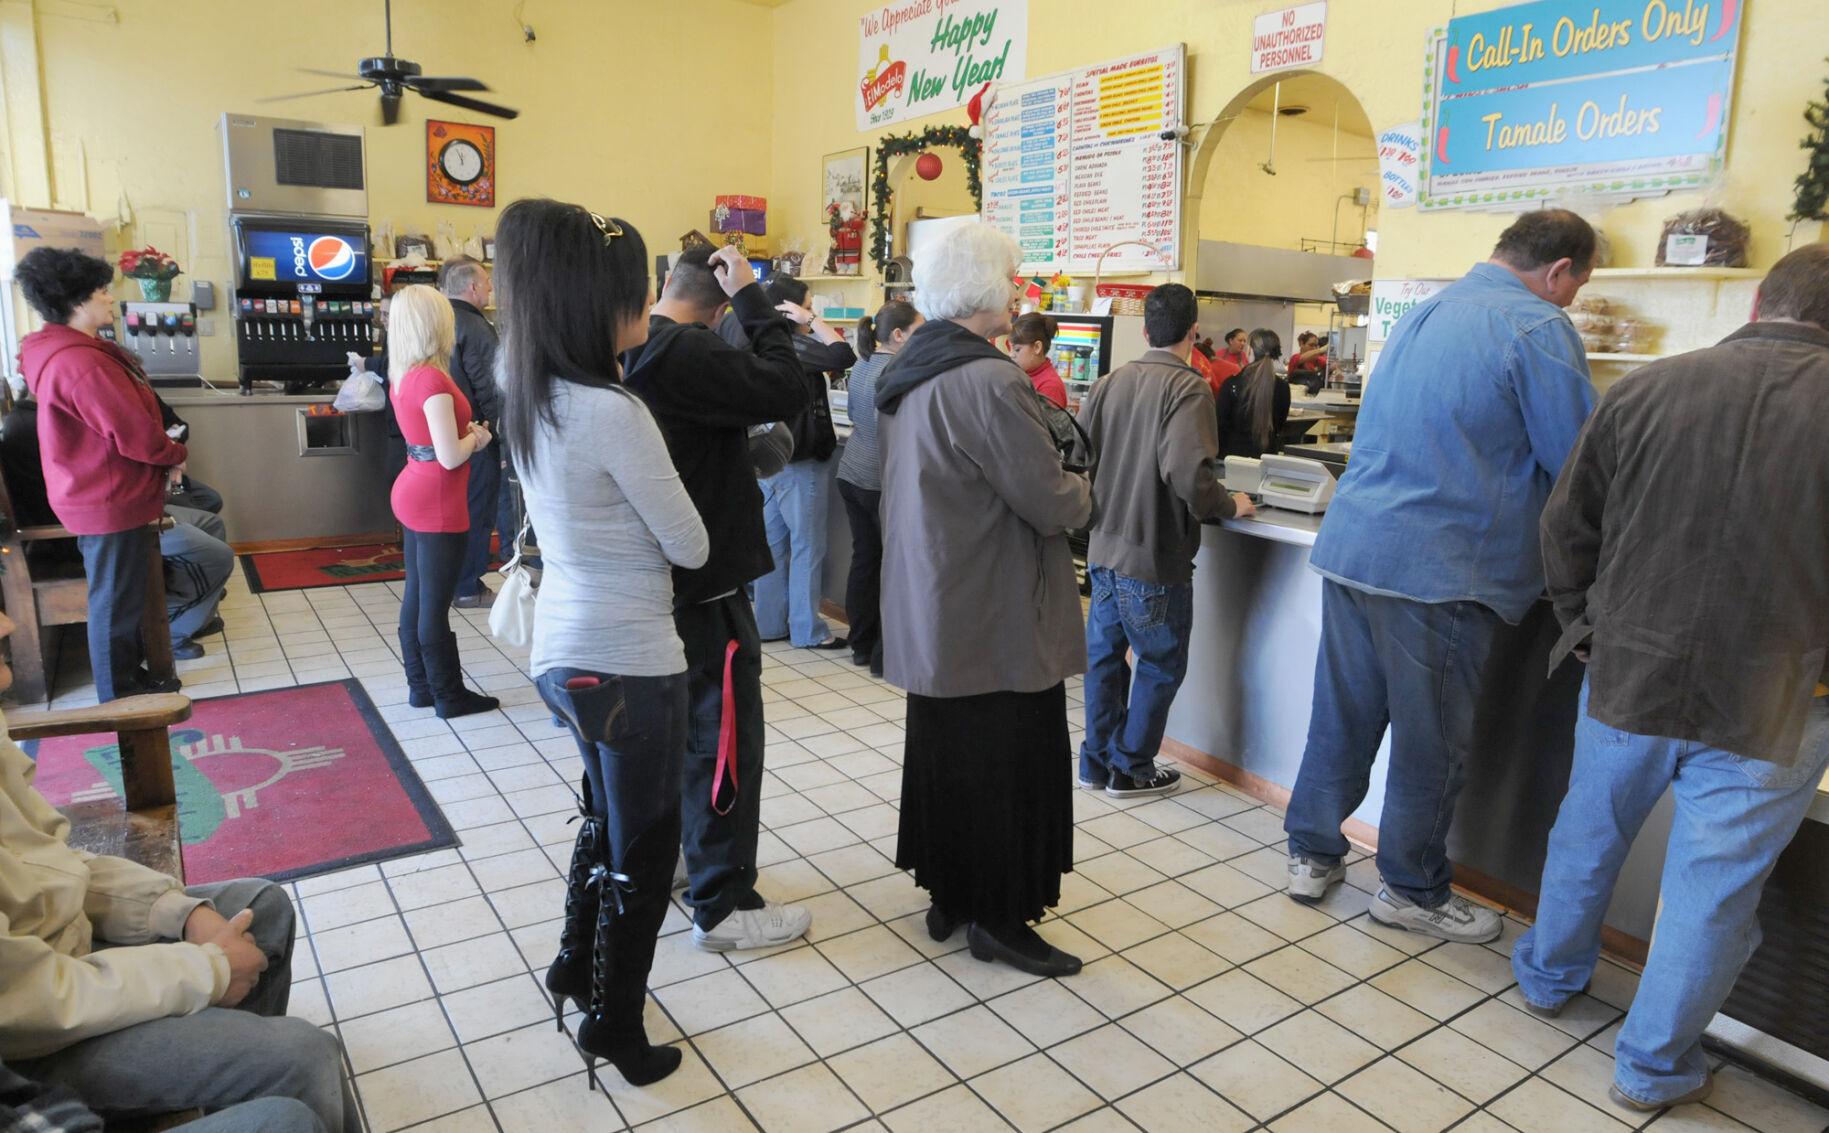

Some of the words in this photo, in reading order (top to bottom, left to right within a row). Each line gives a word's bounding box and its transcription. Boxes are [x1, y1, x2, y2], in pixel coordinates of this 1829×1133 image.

[882, 0, 932, 35] Appreciate
[931, 8, 998, 56] Happy
[1282, 10, 1295, 28] NO
[1254, 23, 1323, 51] UNAUTHORIZED
[1467, 23, 1545, 72] Call-In
[1552, 8, 1632, 57] Orders
[1641, 0, 1709, 45] Only
[907, 69, 947, 107] New
[952, 40, 1012, 102] Year!
[1110, 62, 1128, 71] MADE
[1260, 45, 1312, 69] PERSONNEL
[1481, 102, 1568, 151] Tamale
[1576, 94, 1663, 141] Orders
[1380, 132, 1419, 151] DRINKS
[290, 236, 308, 277] pepsi
